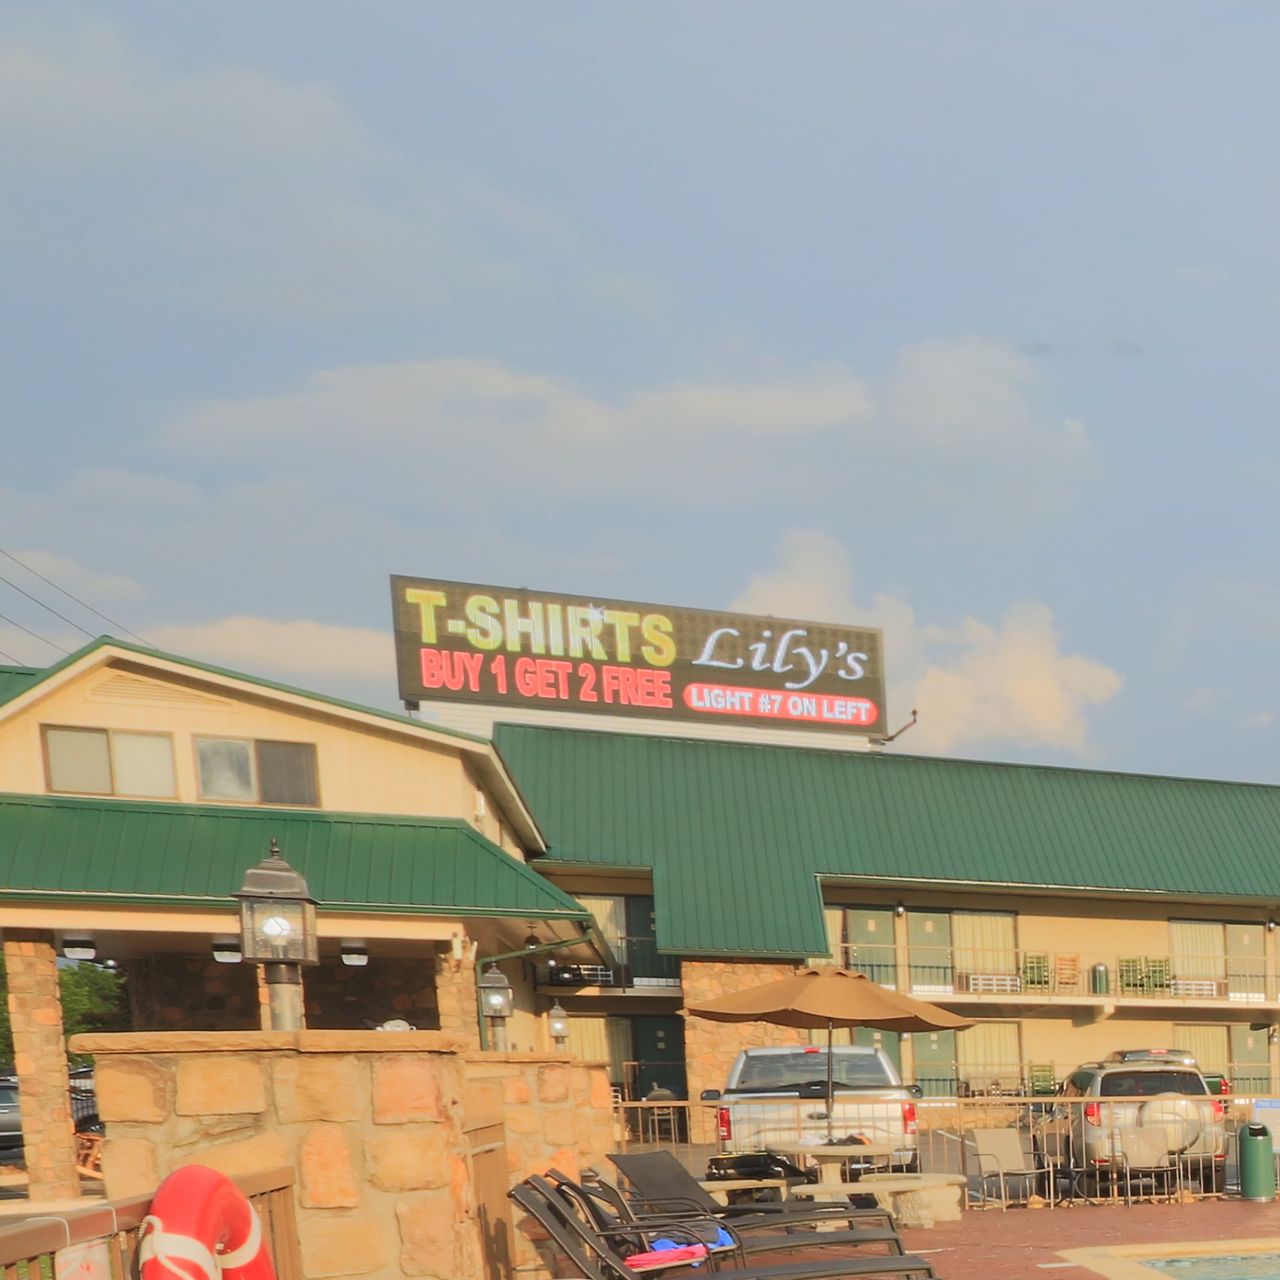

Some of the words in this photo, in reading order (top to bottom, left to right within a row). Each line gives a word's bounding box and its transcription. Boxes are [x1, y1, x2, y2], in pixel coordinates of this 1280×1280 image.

[405, 588, 677, 668] T-SHIRTS
[692, 627, 869, 689] Lily's
[420, 648, 485, 691] BUY
[491, 655, 508, 694] 1
[515, 658, 574, 700] GET
[579, 664, 598, 703] 2
[603, 665, 673, 709] FREE
[691, 688, 753, 712] LIGHT
[759, 692, 782, 714] #7
[790, 695, 816, 716] ON
[823, 698, 871, 722] LEFT
